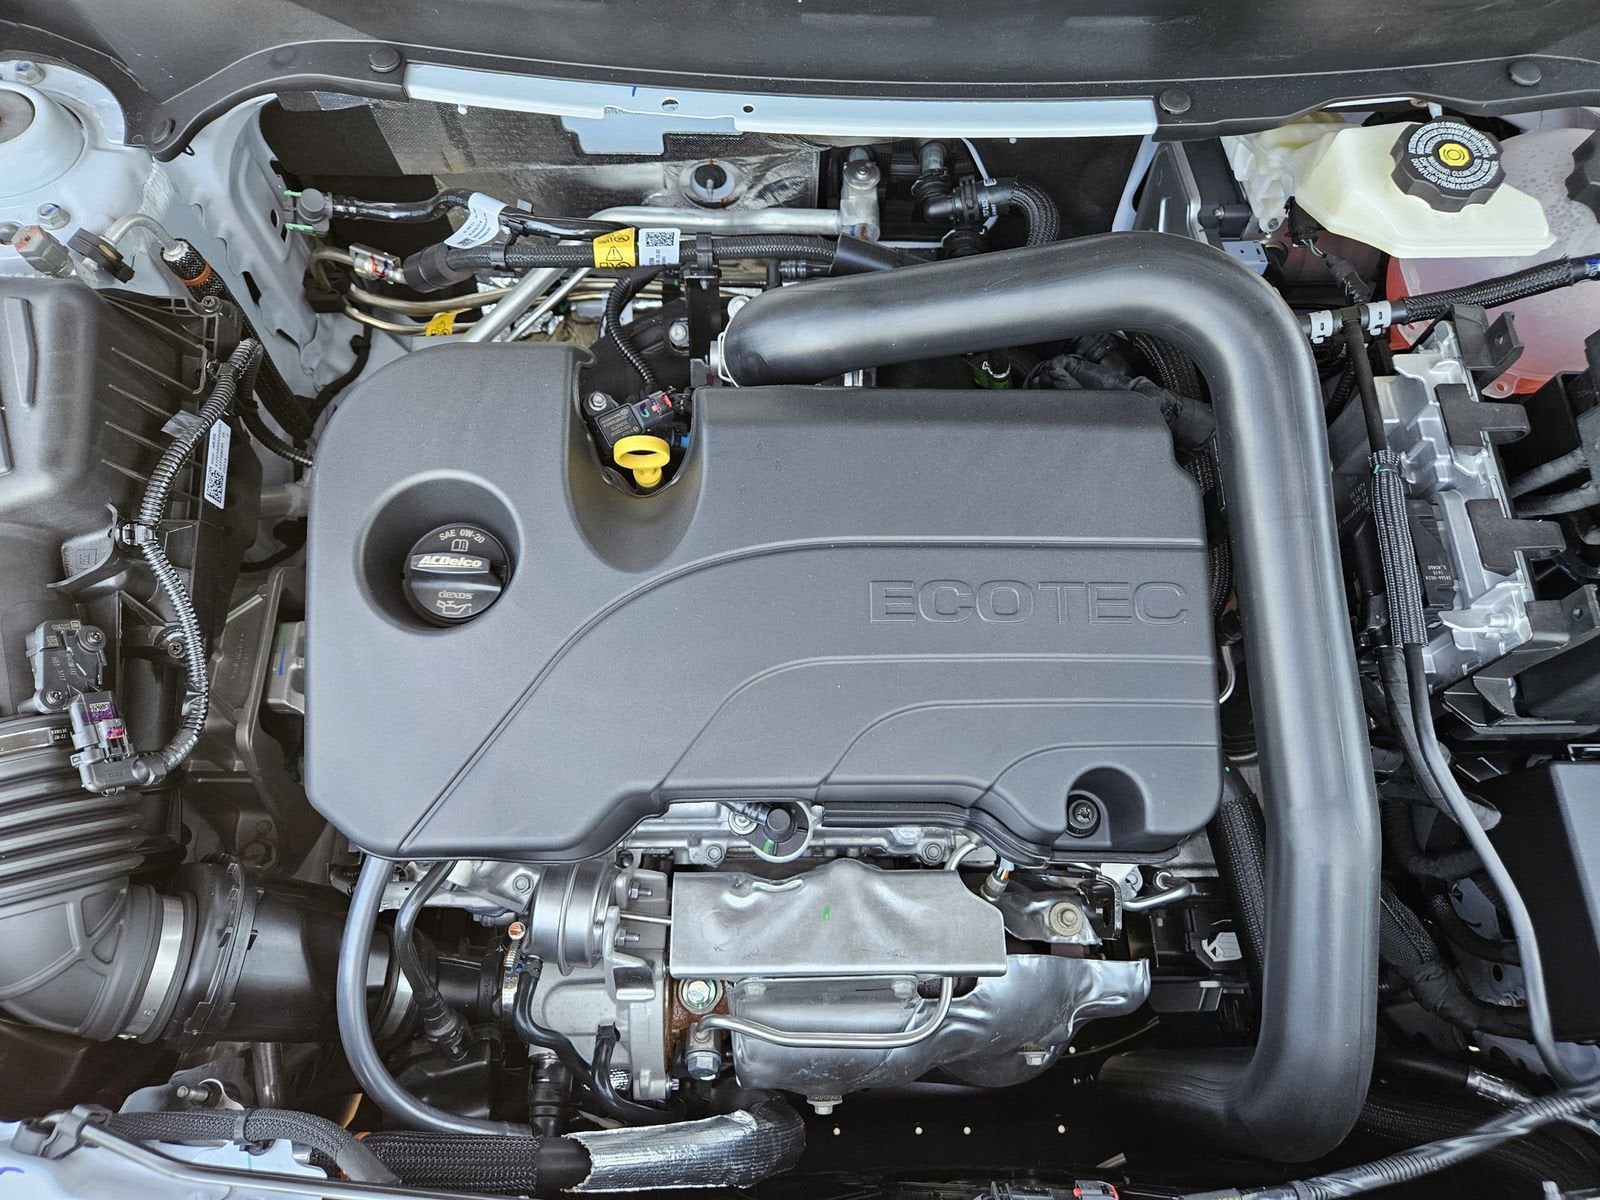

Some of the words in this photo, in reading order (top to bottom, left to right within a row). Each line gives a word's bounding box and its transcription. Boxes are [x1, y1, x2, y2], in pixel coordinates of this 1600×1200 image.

[1420, 169, 1438, 183] FLUID
[1436, 179, 1455, 189] FROM
[439, 529, 456, 541] SAE
[460, 529, 485, 544] 0W-20
[418, 555, 482, 567] ACDelco
[438, 590, 473, 599] dexos
[870, 579, 1188, 625] ECOTEC
